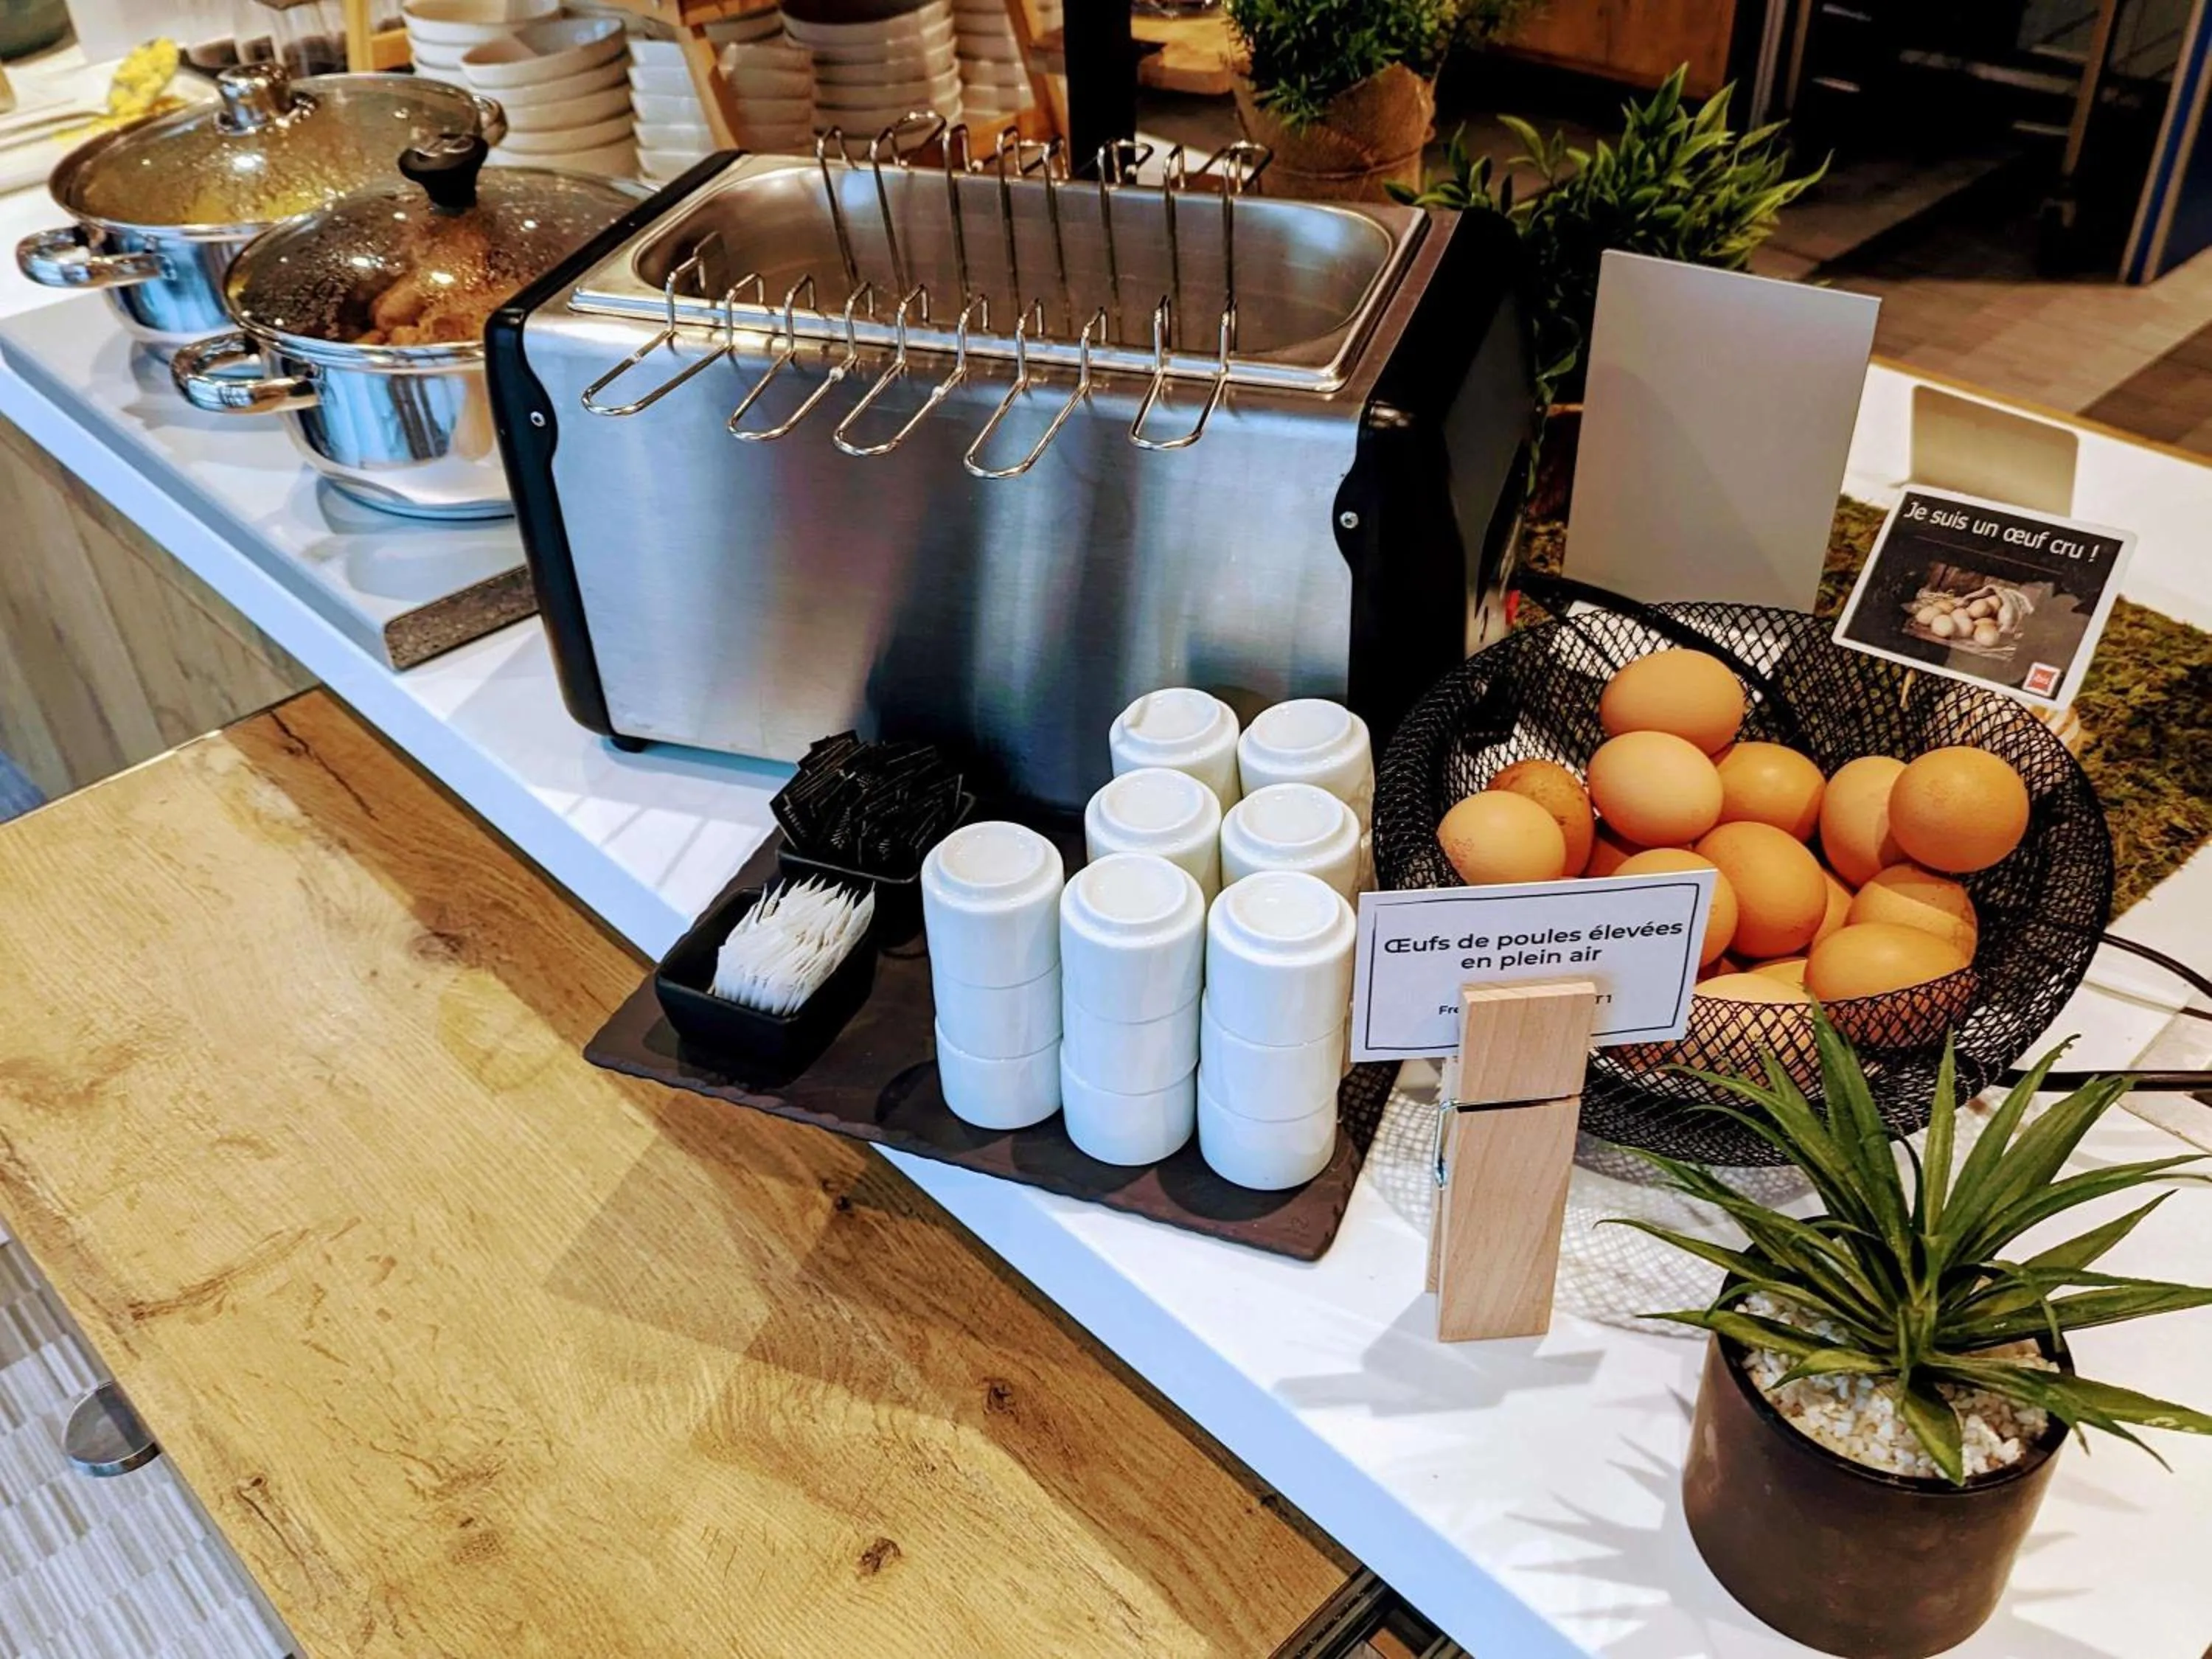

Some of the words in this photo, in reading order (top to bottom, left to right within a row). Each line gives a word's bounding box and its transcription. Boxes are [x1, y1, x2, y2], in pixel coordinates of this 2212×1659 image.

[1903, 501, 1928, 521] Je
[1929, 510, 1969, 530] suis
[1972, 520, 2000, 538] un
[2003, 527, 2051, 549] œuf
[2049, 539, 2084, 560] cru
[1384, 936, 1450, 953] Œufs
[1457, 933, 1489, 949] de
[1497, 928, 1582, 950] poules
[1588, 921, 1683, 940] élevées
[1461, 956, 1492, 970] en
[1500, 949, 1562, 970] plein
[1569, 946, 1603, 962] air
